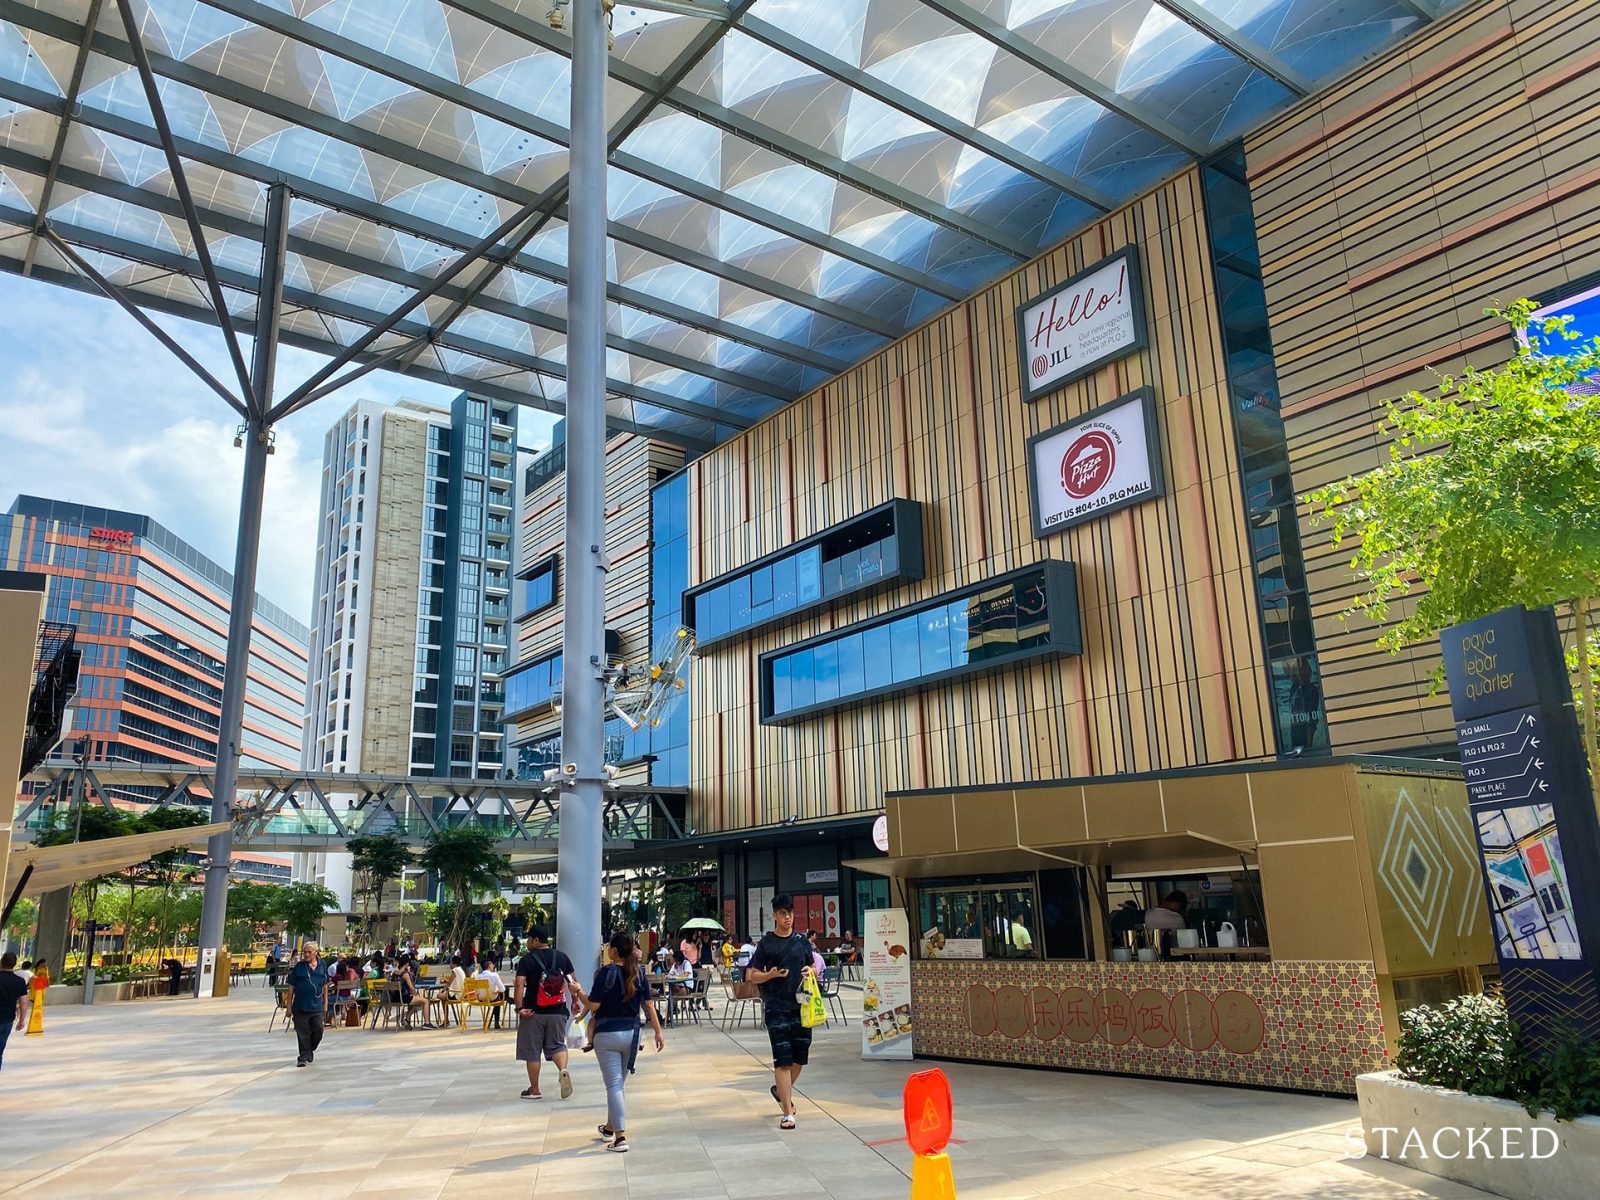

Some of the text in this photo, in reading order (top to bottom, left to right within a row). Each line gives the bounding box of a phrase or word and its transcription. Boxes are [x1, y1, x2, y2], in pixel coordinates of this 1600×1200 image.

[1030, 265, 1125, 348] Hello!
[1078, 309, 1130, 342] Our new regional
[1079, 325, 1121, 349] headquarters
[1086, 345, 1100, 356] now
[1107, 333, 1120, 347] PLQ
[1080, 423, 1093, 432] YOUR
[1093, 422, 1106, 430] SLICE
[1111, 429, 1122, 445] SIMPLE
[1072, 456, 1102, 483] Pizza
[1077, 465, 1101, 489] Hut
[1044, 481, 1149, 525] VISIT US #04-10, PLQ MALL
[1463, 629, 1495, 656] paya
[1464, 654, 1497, 676] lebar
[1466, 673, 1514, 702] quarter
[1461, 724, 1491, 737] PLQ MALL
[1464, 748, 1477, 757] PLQ
[1481, 745, 1487, 753] &
[1487, 744, 1500, 752] PLQ
[1500, 742, 1506, 750] 2
[1468, 767, 1486, 777] PLQ 3
[1471, 782, 1507, 795] PARK PLACE
